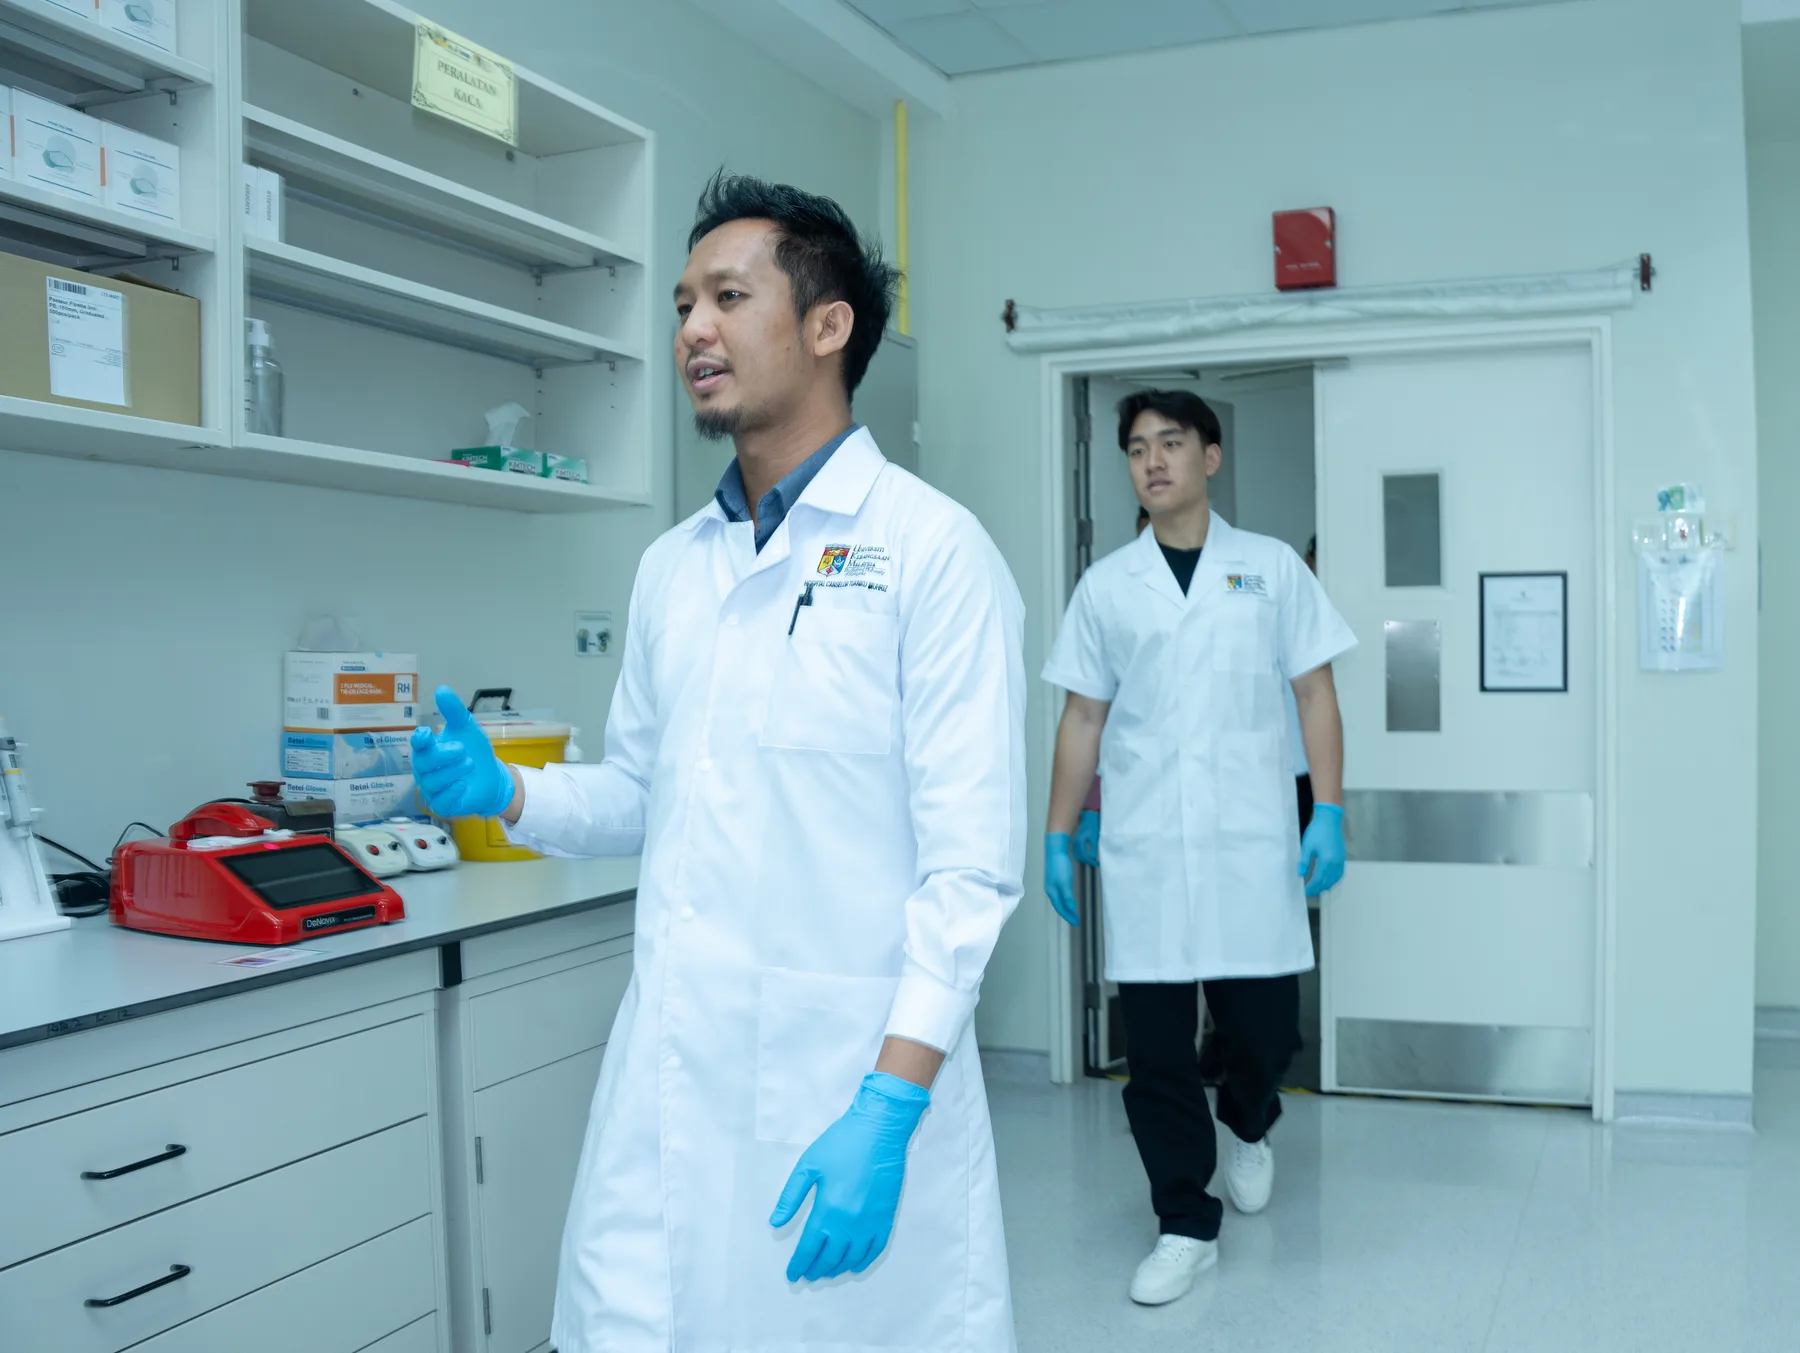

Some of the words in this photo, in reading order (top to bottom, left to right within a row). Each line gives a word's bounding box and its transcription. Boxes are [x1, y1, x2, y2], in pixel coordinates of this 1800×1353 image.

[437, 60, 497, 96] PERALATAN
[454, 88, 483, 109] KACA
[461, 454, 488, 463] KIMTECH
[508, 459, 536, 472] KIMTECH
[555, 468, 581, 479] KIMTECH
[397, 683, 410, 693] RH
[305, 785, 327, 793] Gloves
[306, 916, 336, 928] DeNovix
